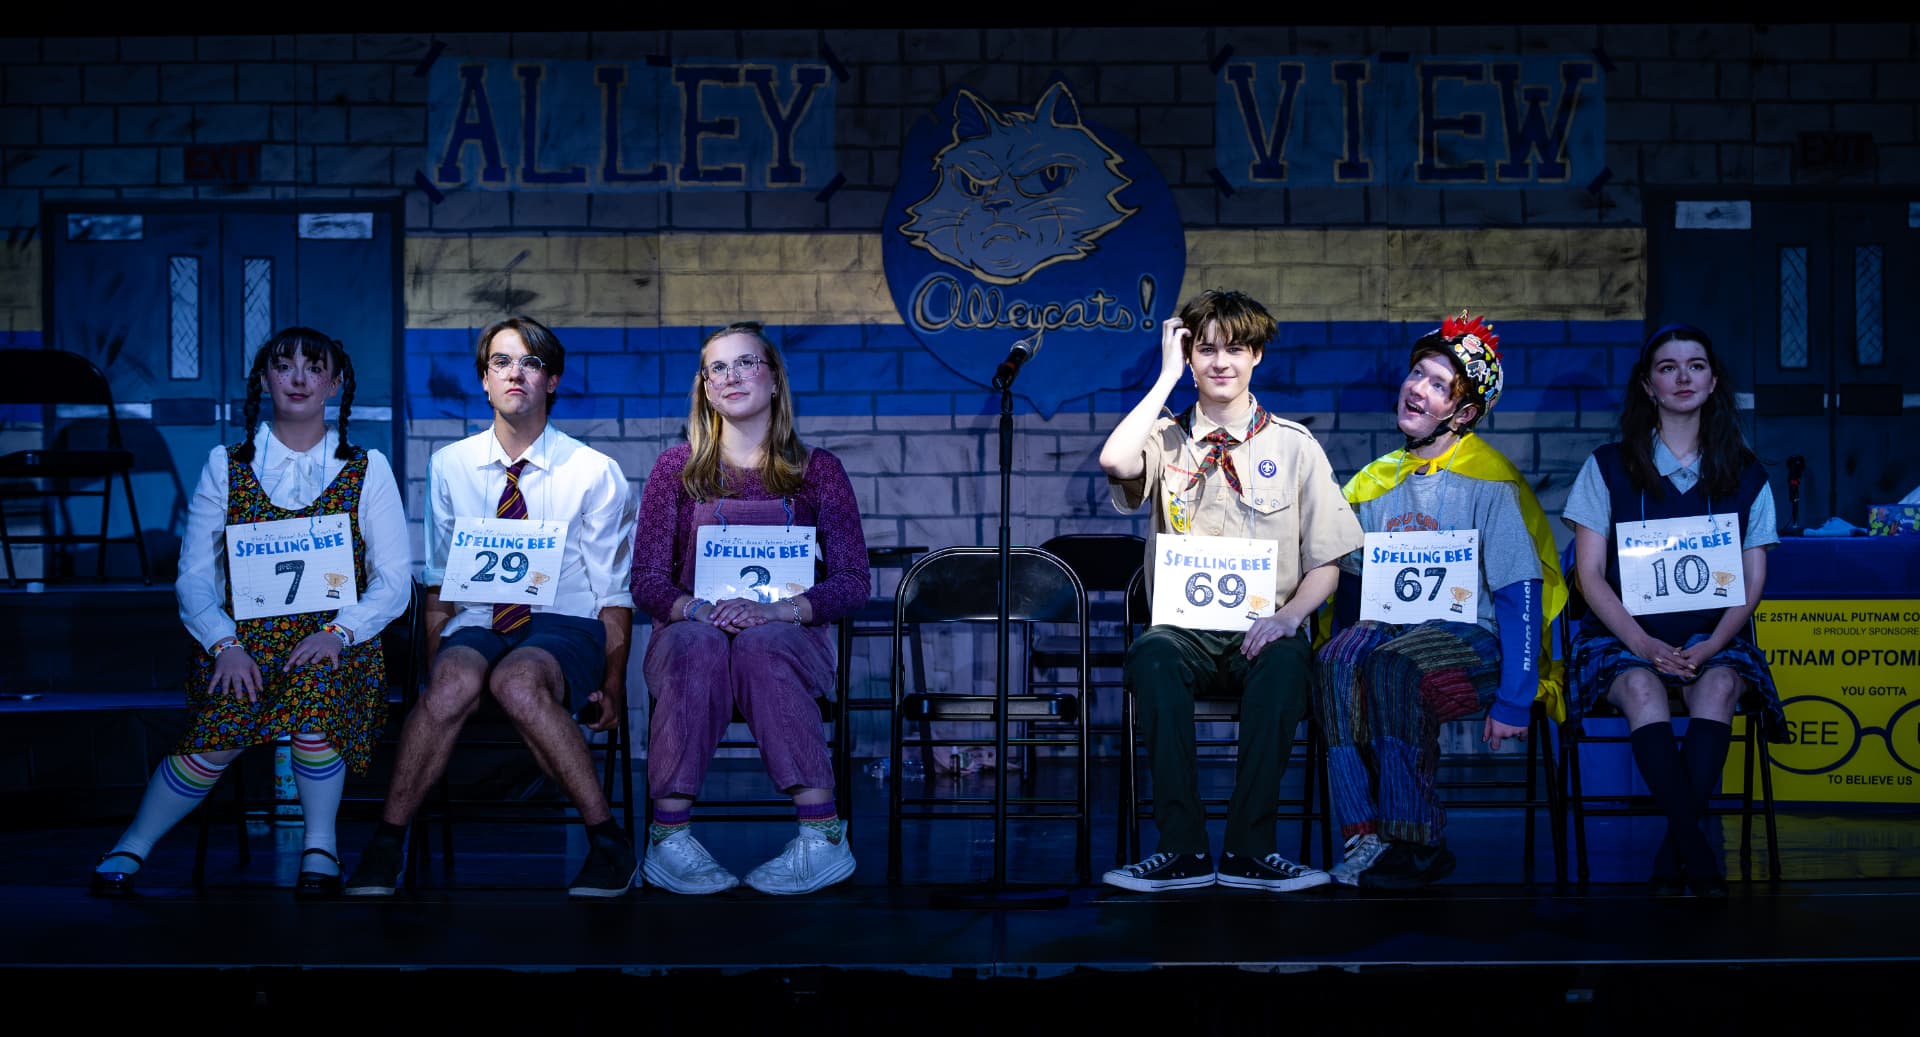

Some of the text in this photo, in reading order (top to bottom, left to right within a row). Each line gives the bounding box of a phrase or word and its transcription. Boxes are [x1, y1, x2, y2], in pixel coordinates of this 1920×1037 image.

[434, 63, 831, 186] ALLEY
[1224, 60, 1597, 183] VIEW
[235, 538, 310, 557] SPELLING
[313, 532, 344, 550] BEE
[454, 530, 524, 549] SPELLING
[528, 536, 556, 549] BEE
[704, 540, 809, 559] SPELLING BEE
[1701, 532, 1732, 549] BEE
[470, 550, 529, 583] 29
[1163, 549, 1237, 570] SPELLING
[1241, 557, 1271, 571] BEE
[1371, 546, 1473, 564] SPELLING BEE
[275, 560, 305, 605] 7
[1394, 566, 1447, 602] 67
[1652, 554, 1710, 597] 10
[1185, 571, 1247, 608] 69
[1770, 612, 1797, 623] 25TH
[1800, 612, 1846, 623] ANNUAL
[1851, 612, 1900, 623] PUTNAM
[1813, 627, 1822, 636] IS
[1824, 627, 1866, 636] PROUDLY
[1841, 686, 1907, 696] YOU GOTTA
[1785, 721, 1839, 745] SEE
[1828, 775, 1913, 786] TO BELIEVE US
